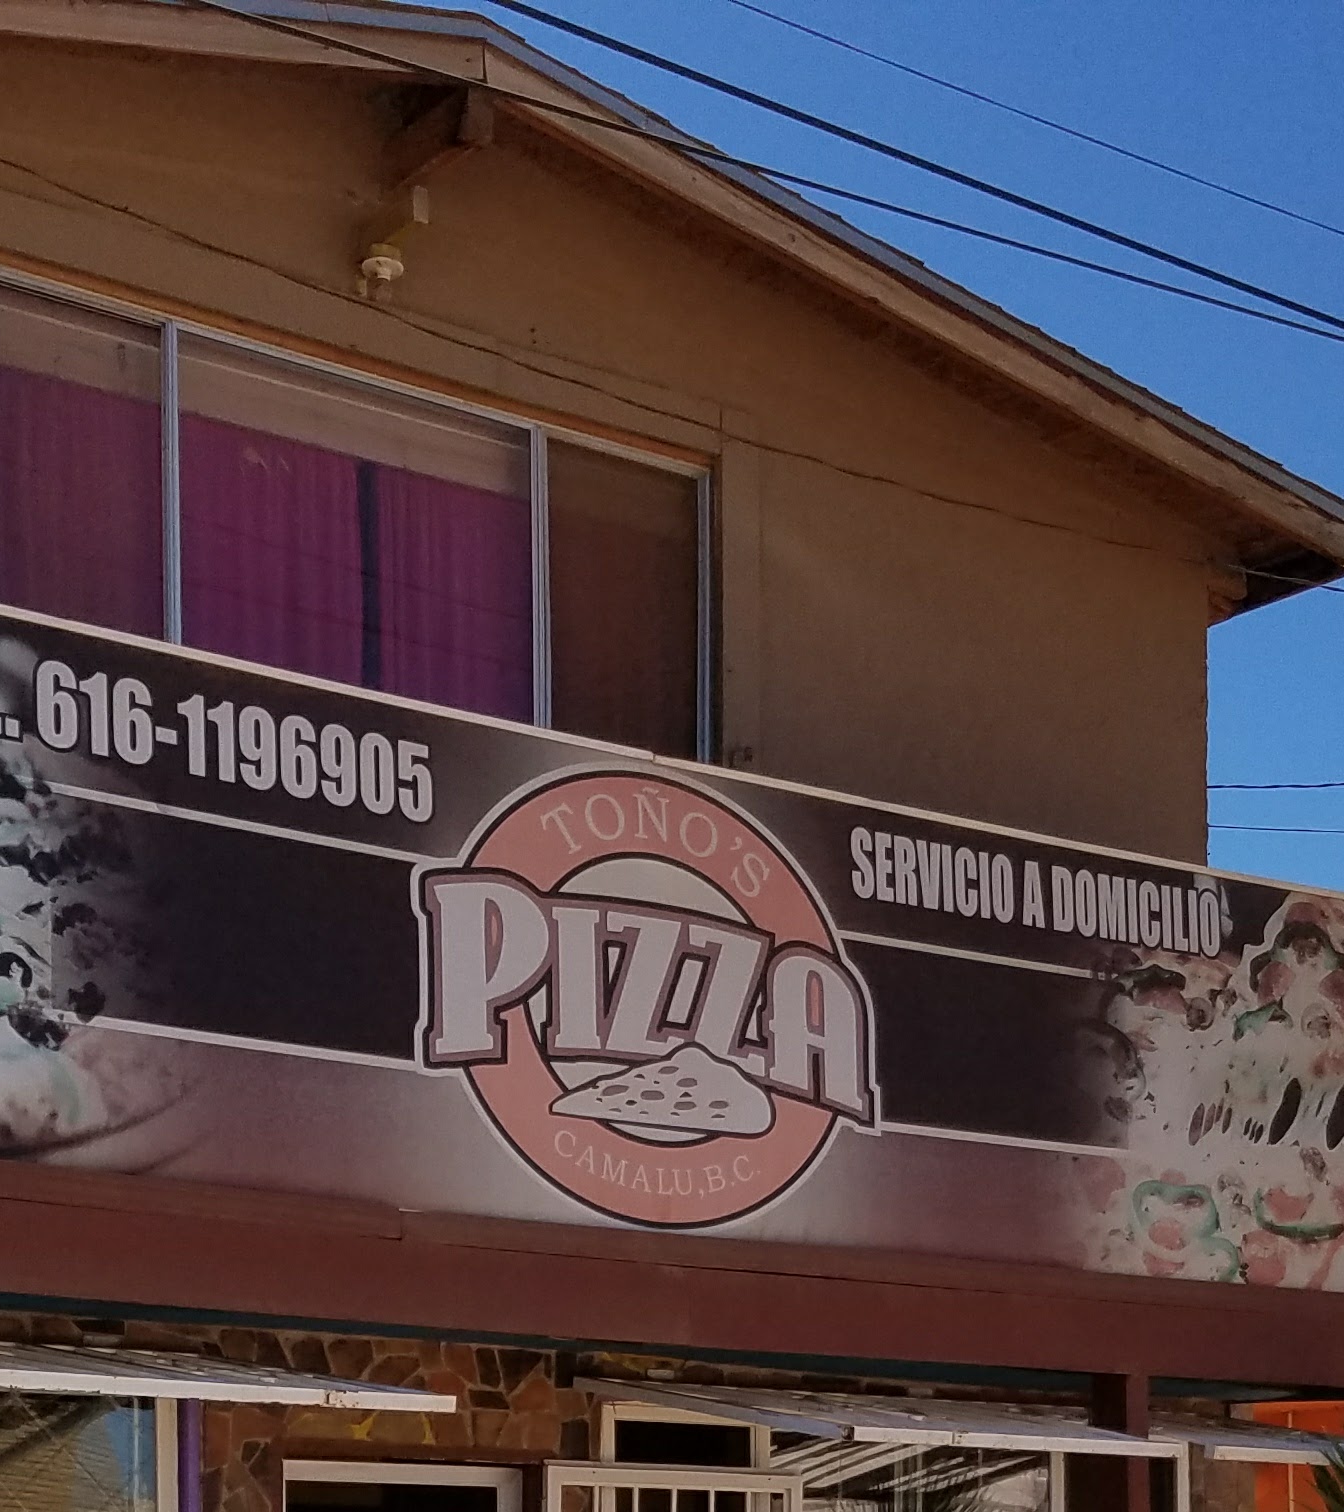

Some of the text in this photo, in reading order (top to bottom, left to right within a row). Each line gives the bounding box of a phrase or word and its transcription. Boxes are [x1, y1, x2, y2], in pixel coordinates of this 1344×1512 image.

[35, 659, 433, 823] 616-1196905
[541, 787, 771, 898] TOÑO'S
[850, 827, 1220, 958] SERVICIO A DOMICILIO
[430, 880, 864, 1112] PIZZA
